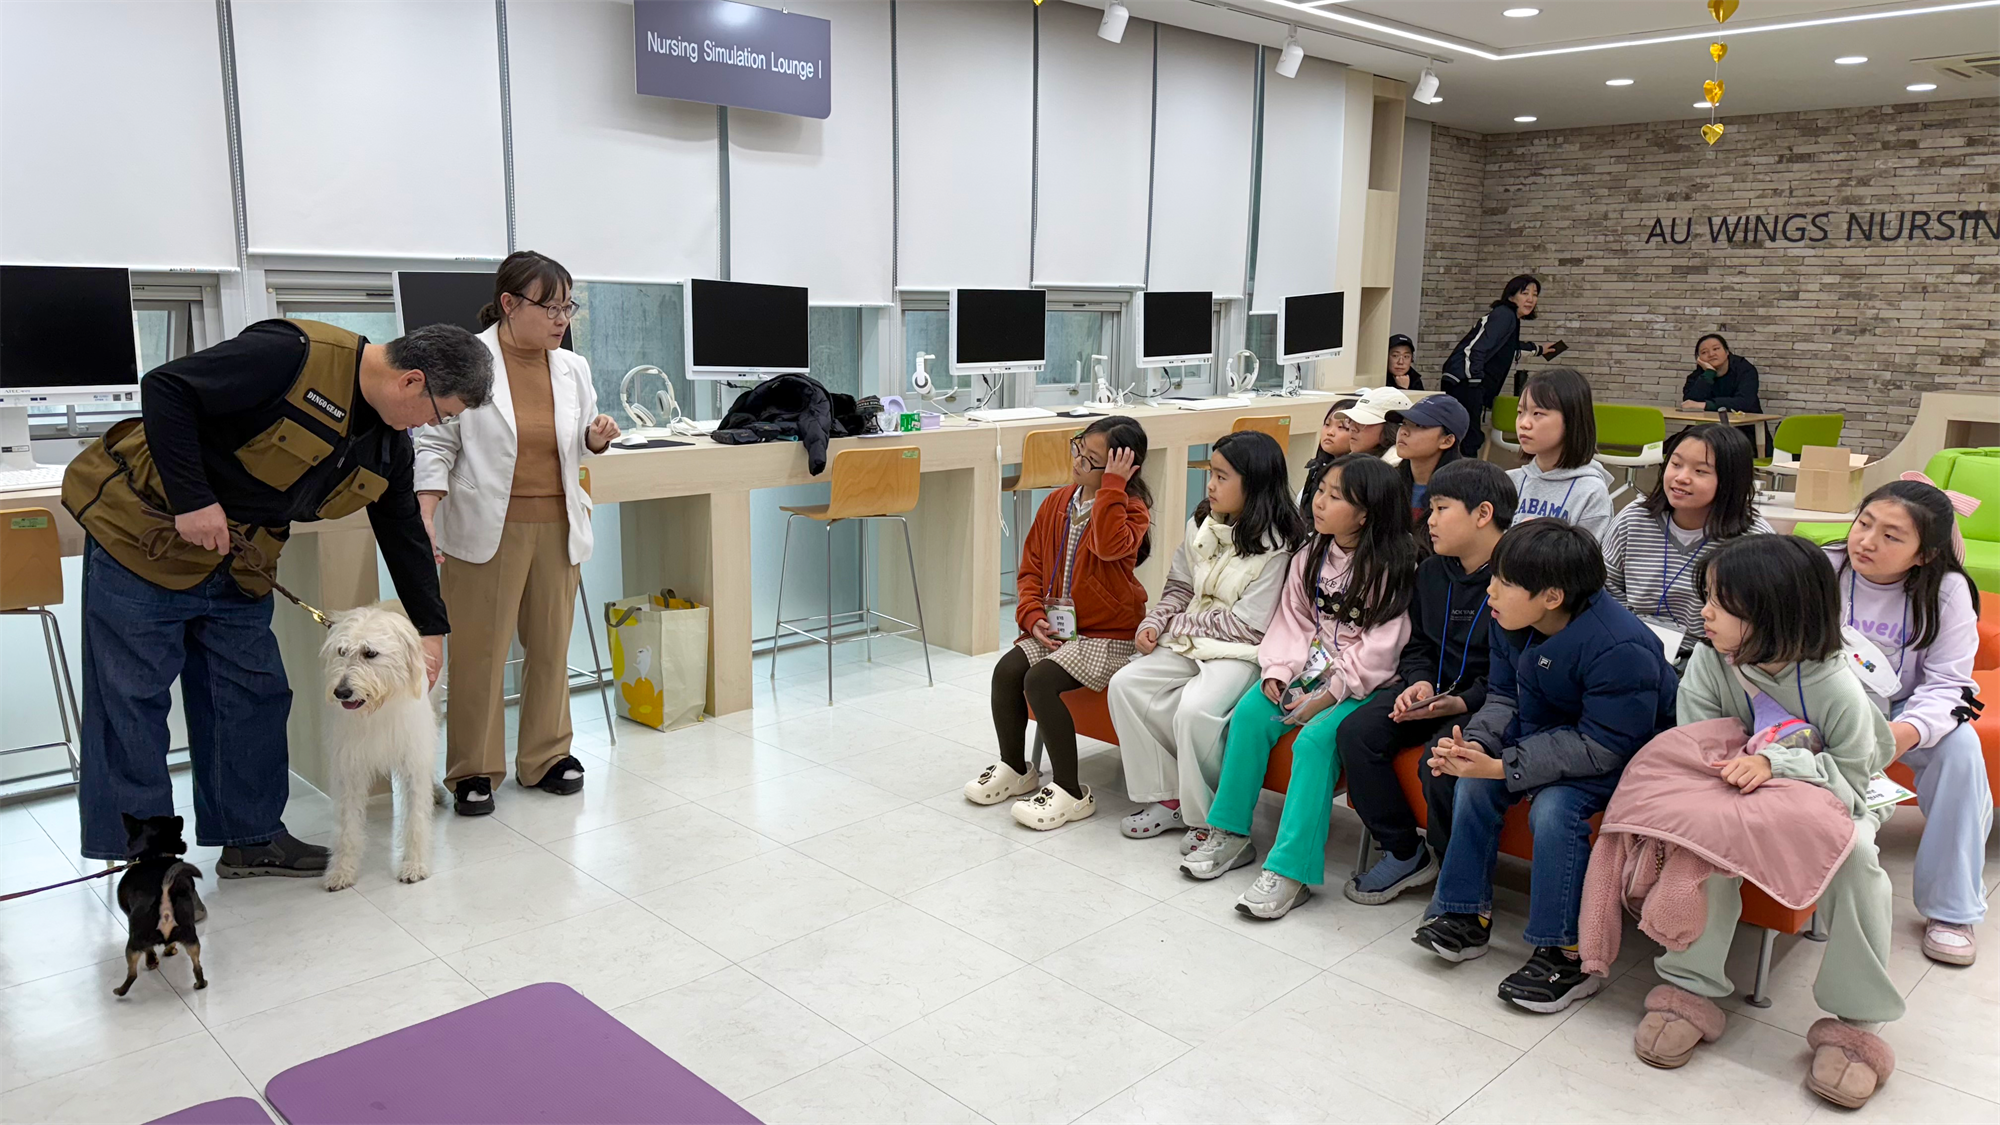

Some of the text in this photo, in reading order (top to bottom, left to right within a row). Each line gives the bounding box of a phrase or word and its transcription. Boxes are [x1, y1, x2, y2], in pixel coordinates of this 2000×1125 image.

[647, 30, 698, 63] Nursing
[703, 39, 766, 70] Simulation
[771, 51, 814, 81] Lounge
[1645, 216, 1693, 244] AU
[1707, 211, 1833, 244] WINGS
[306, 391, 328, 408] DINGO
[1515, 497, 1569, 519] ABAMA
[1847, 619, 1912, 645] ovely
